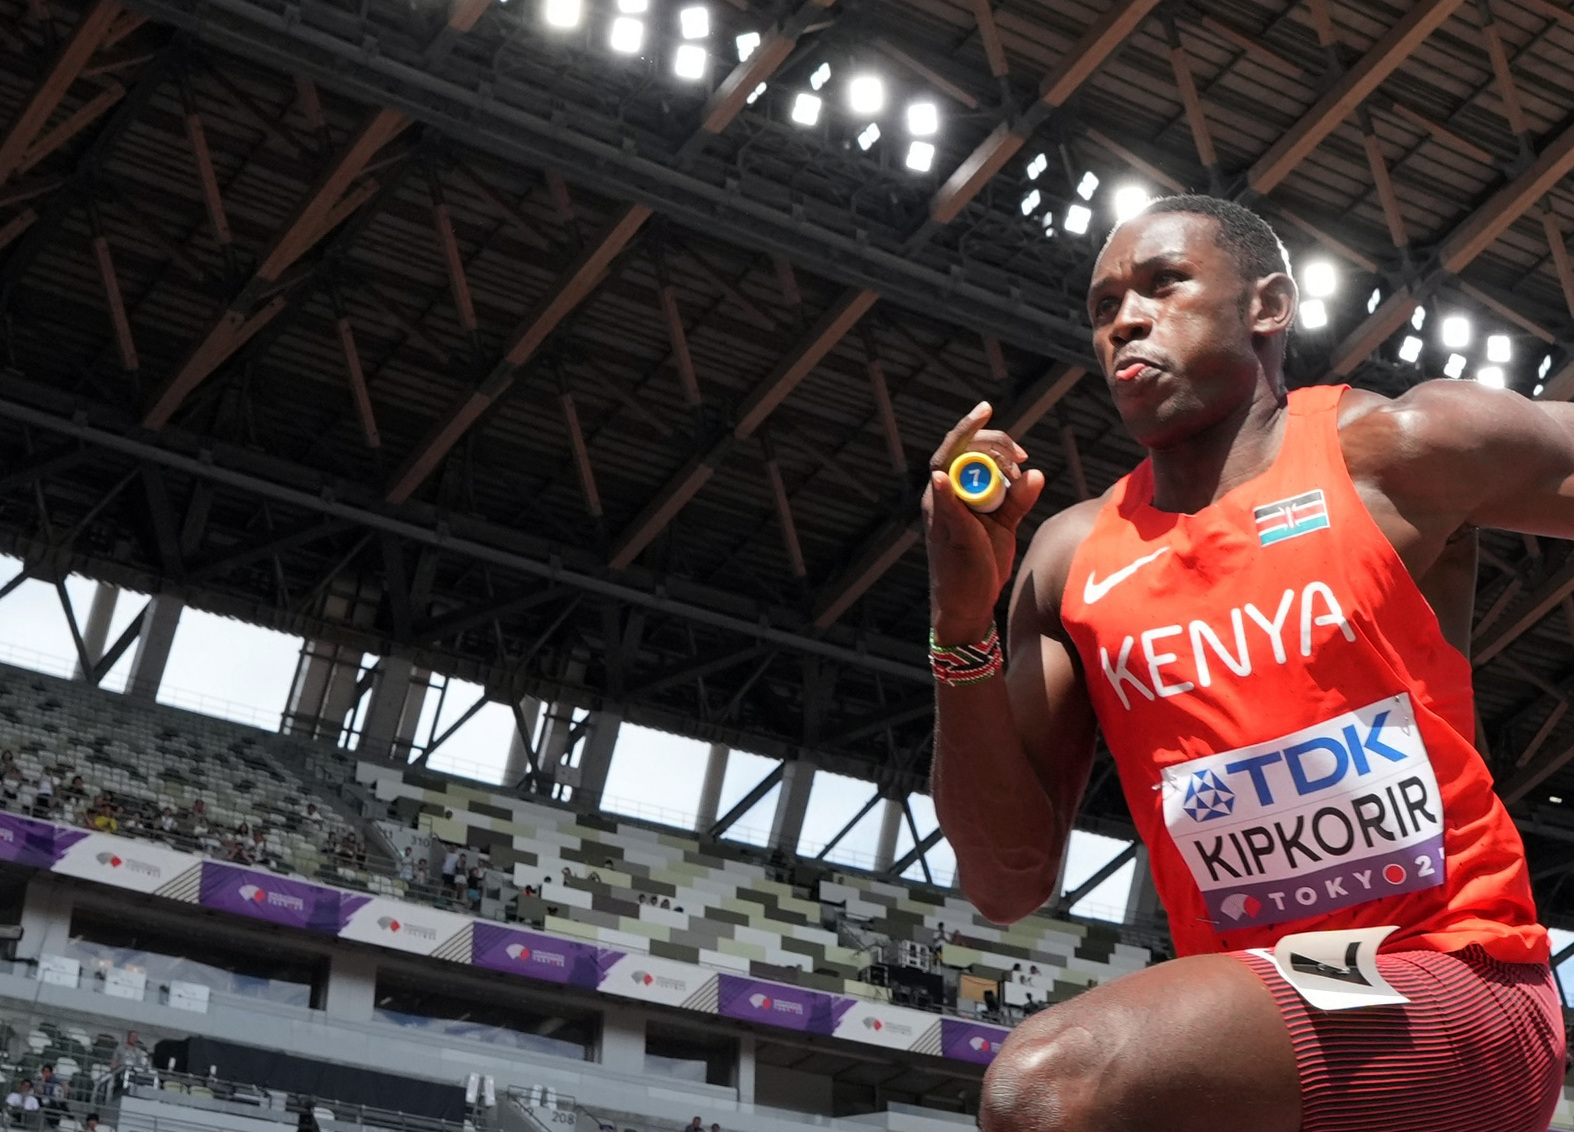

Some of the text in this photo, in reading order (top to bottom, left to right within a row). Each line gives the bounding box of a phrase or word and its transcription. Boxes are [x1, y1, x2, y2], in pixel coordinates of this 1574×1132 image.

[968, 469, 981, 487] 7
[1100, 581, 1356, 710] KENYA
[1225, 710, 1408, 806] TDK
[1193, 776, 1437, 881] KIPKORIR
[1414, 847, 1444, 878] 2
